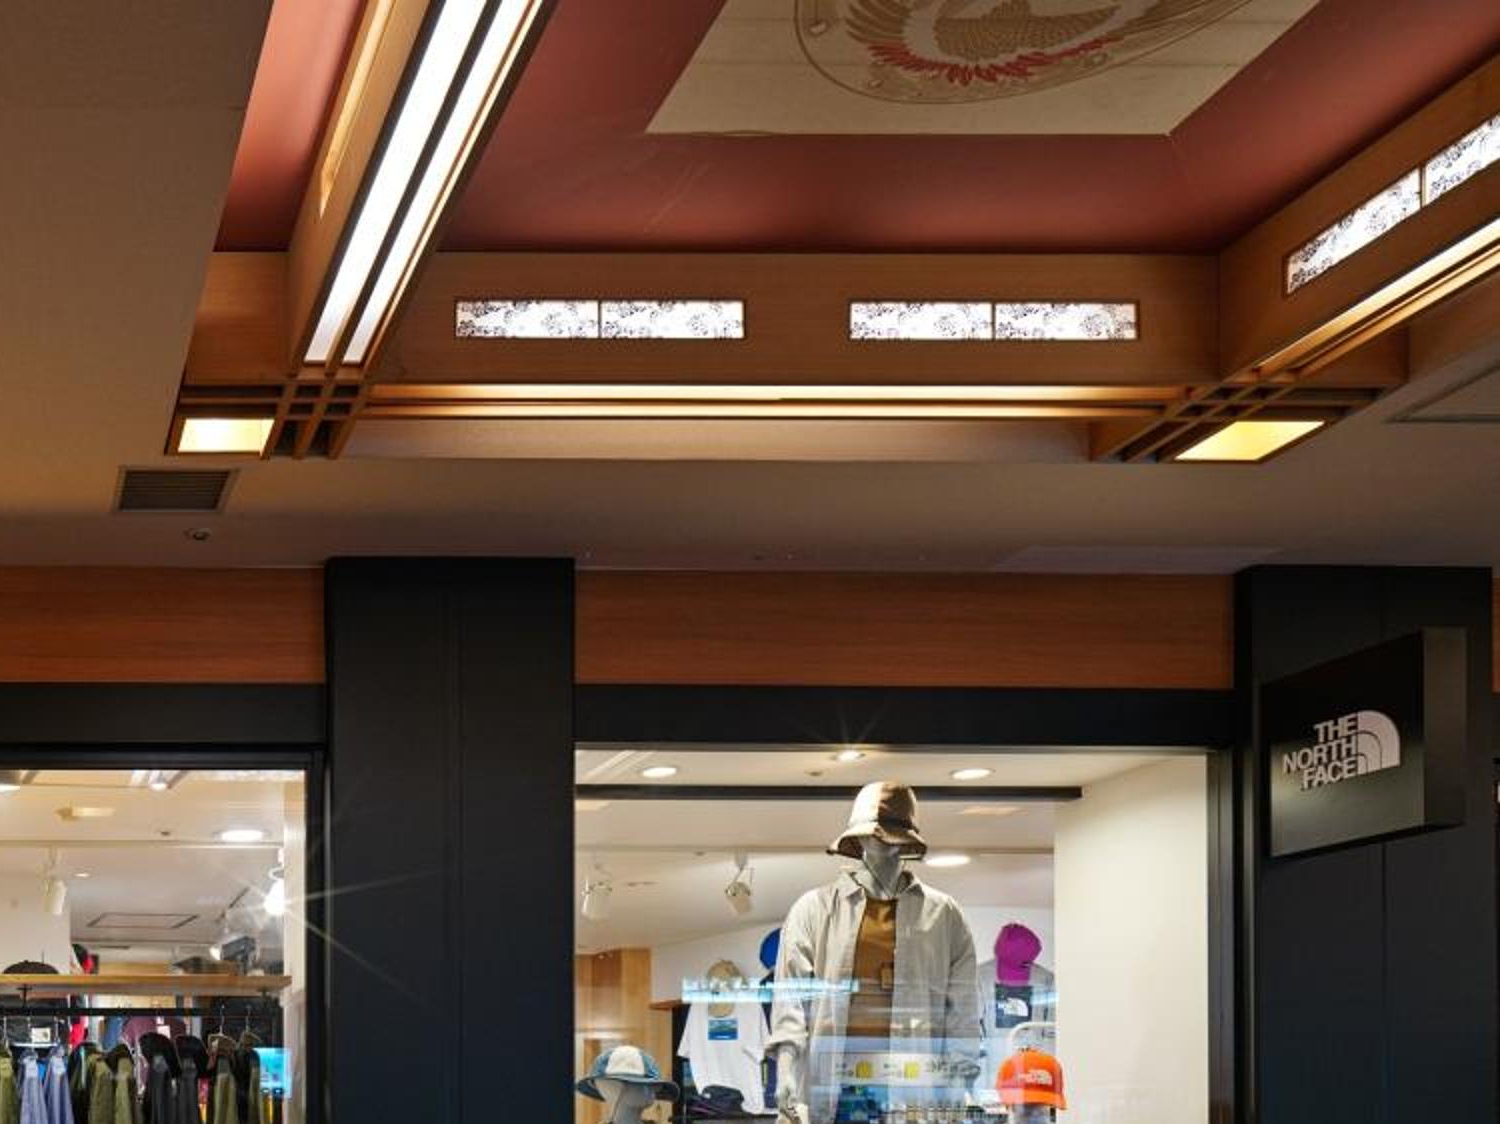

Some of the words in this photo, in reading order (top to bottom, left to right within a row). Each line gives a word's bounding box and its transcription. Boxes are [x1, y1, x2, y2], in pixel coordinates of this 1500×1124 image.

[1313, 713, 1357, 742] THE
[1283, 735, 1356, 774] NORTH
[1303, 757, 1357, 789] FACE
